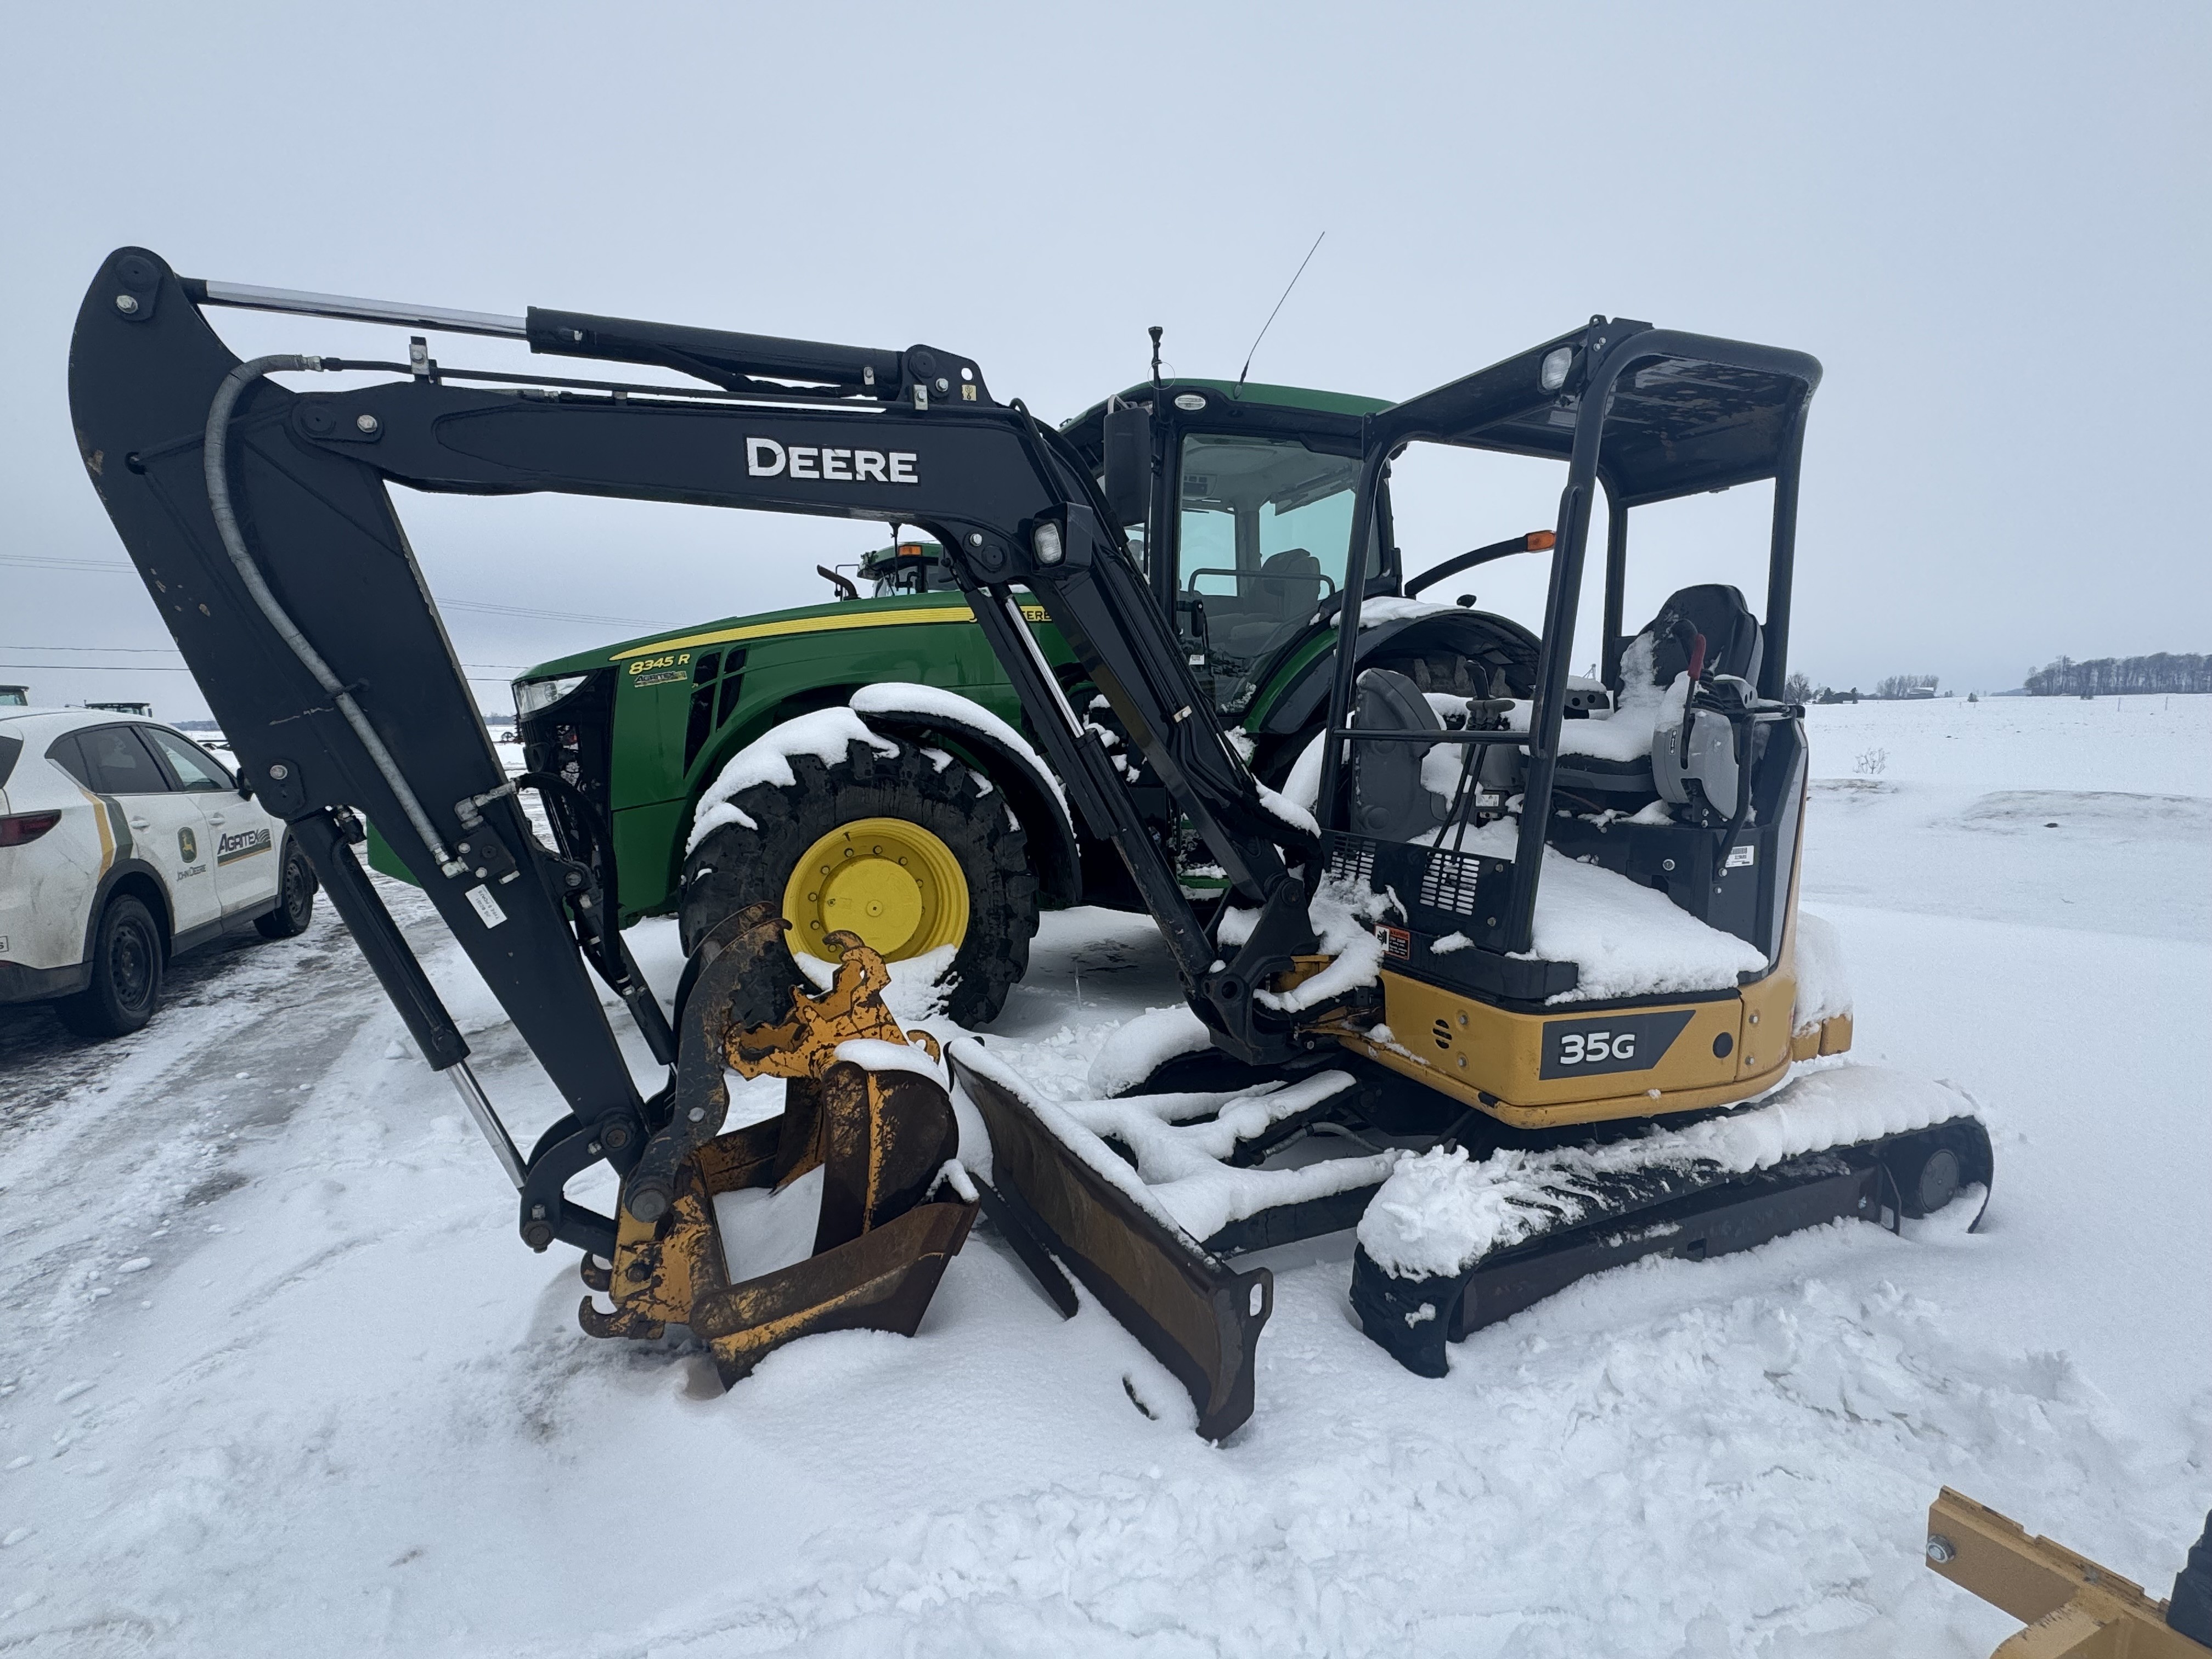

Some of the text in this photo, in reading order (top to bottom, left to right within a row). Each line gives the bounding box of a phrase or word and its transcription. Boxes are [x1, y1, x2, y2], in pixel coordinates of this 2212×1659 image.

[746, 437, 918, 483] DEERE
[629, 653, 690, 675] 8345 R
[635, 672, 675, 681] AGRITEX
[217, 828, 259, 855] AGRITEX
[1560, 1031, 1635, 1064] 35G
